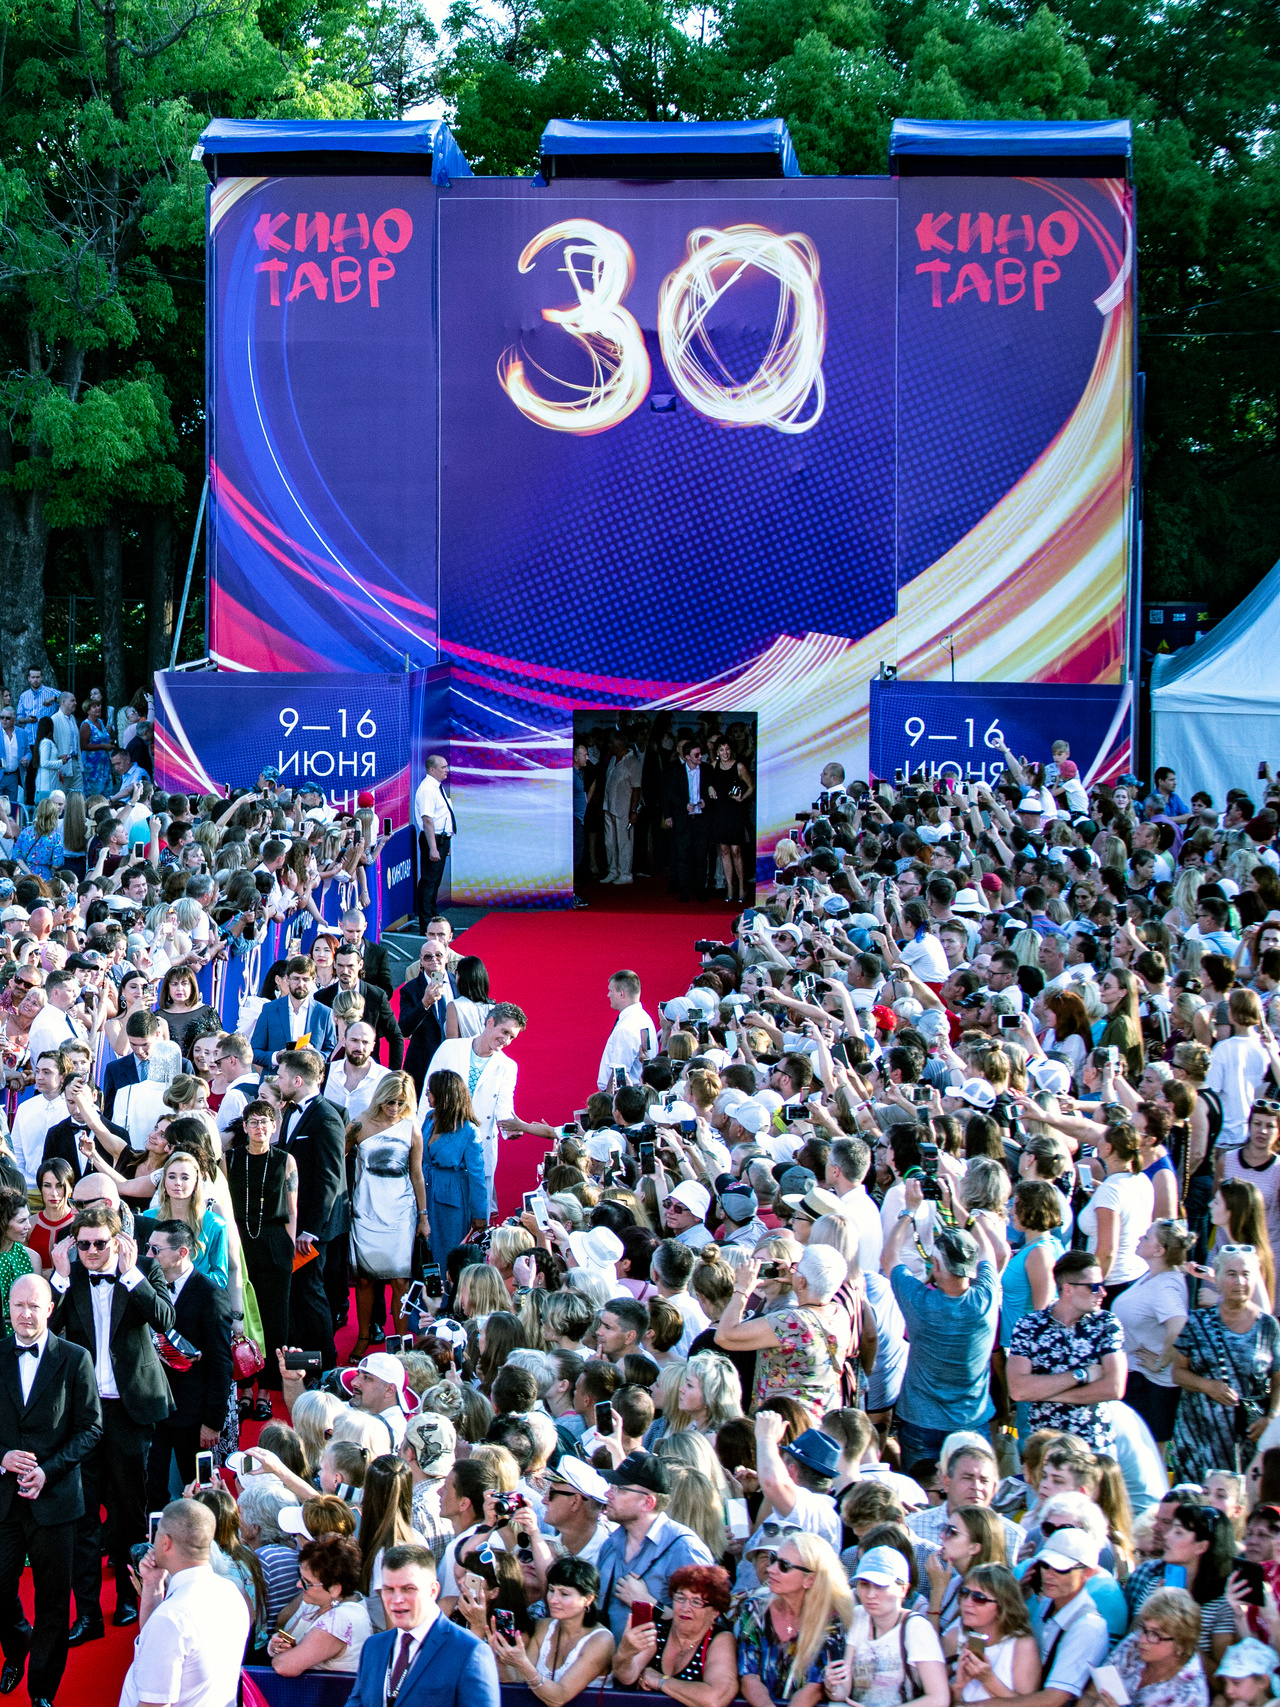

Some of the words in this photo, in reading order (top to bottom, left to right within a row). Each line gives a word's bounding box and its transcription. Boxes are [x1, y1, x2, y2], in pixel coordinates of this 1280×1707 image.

[254, 208, 413, 256] КИНО
[915, 210, 1080, 259] КИНО
[254, 256, 395, 307] ТАВР
[915, 258, 1061, 311] ТАВР
[497, 218, 825, 436] 30
[278, 750, 376, 777] ИЮНЯ
